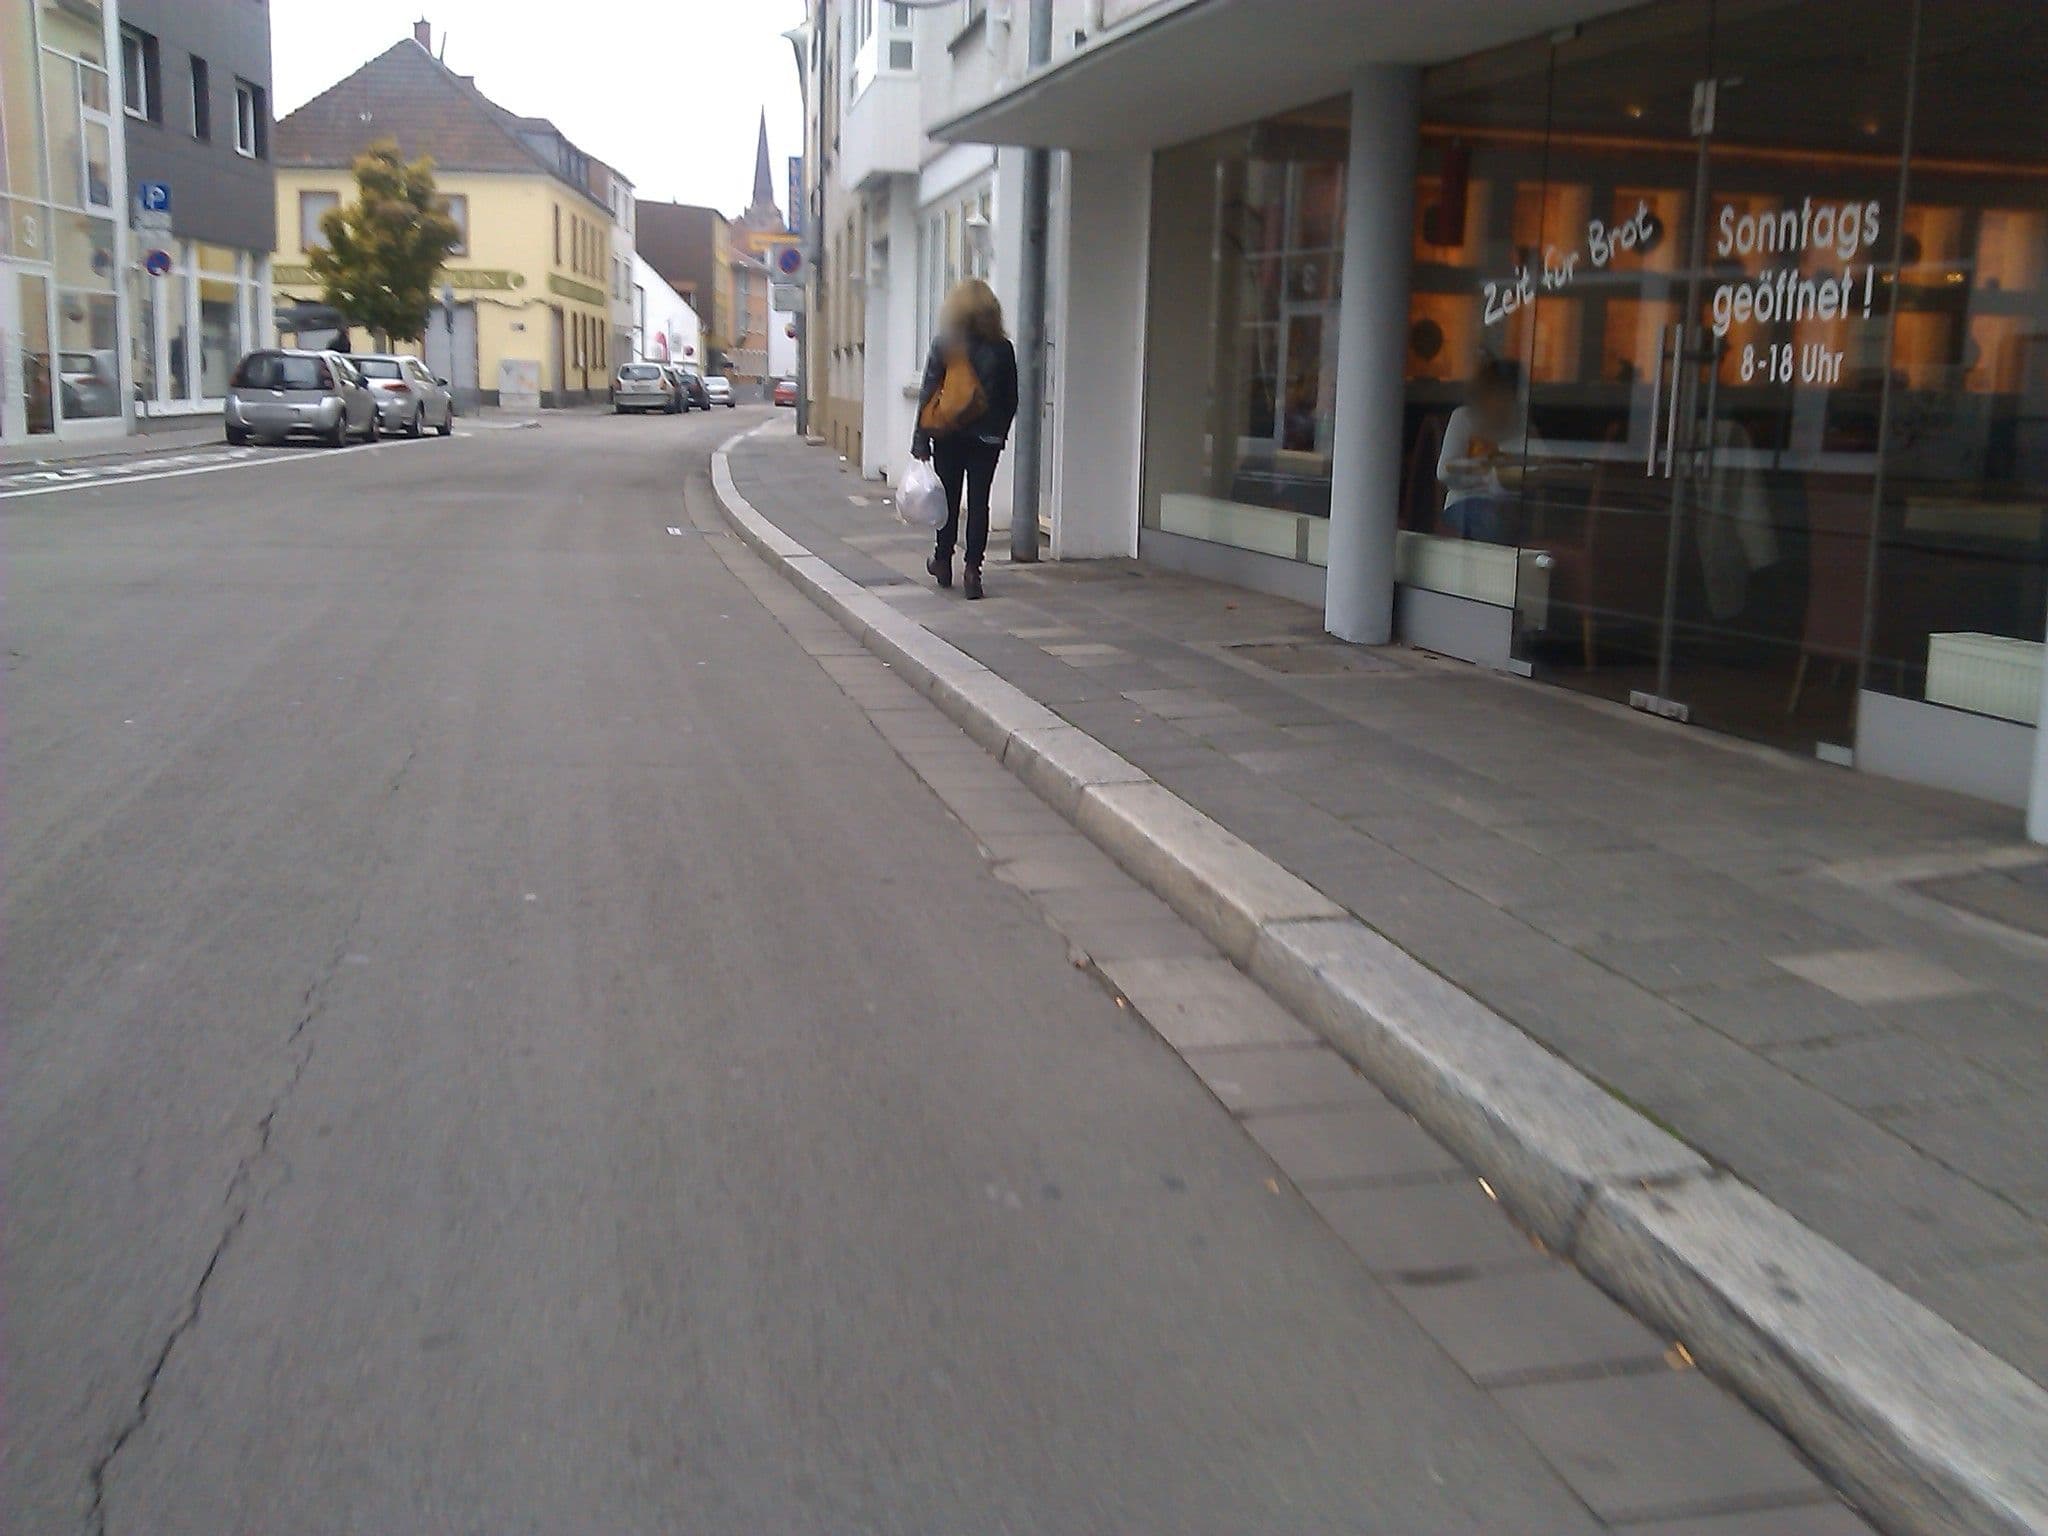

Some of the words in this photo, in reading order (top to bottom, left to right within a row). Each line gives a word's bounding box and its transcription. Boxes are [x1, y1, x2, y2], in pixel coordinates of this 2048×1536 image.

[147, 186, 166, 209] P
[1718, 197, 1880, 260] Sonntags
[1484, 264, 1535, 326] Zeit
[1588, 200, 1653, 267] Brot
[1712, 267, 1853, 337] geöffnet
[1740, 343, 1793, 383] 8-18
[1801, 344, 1844, 384] Uhr
